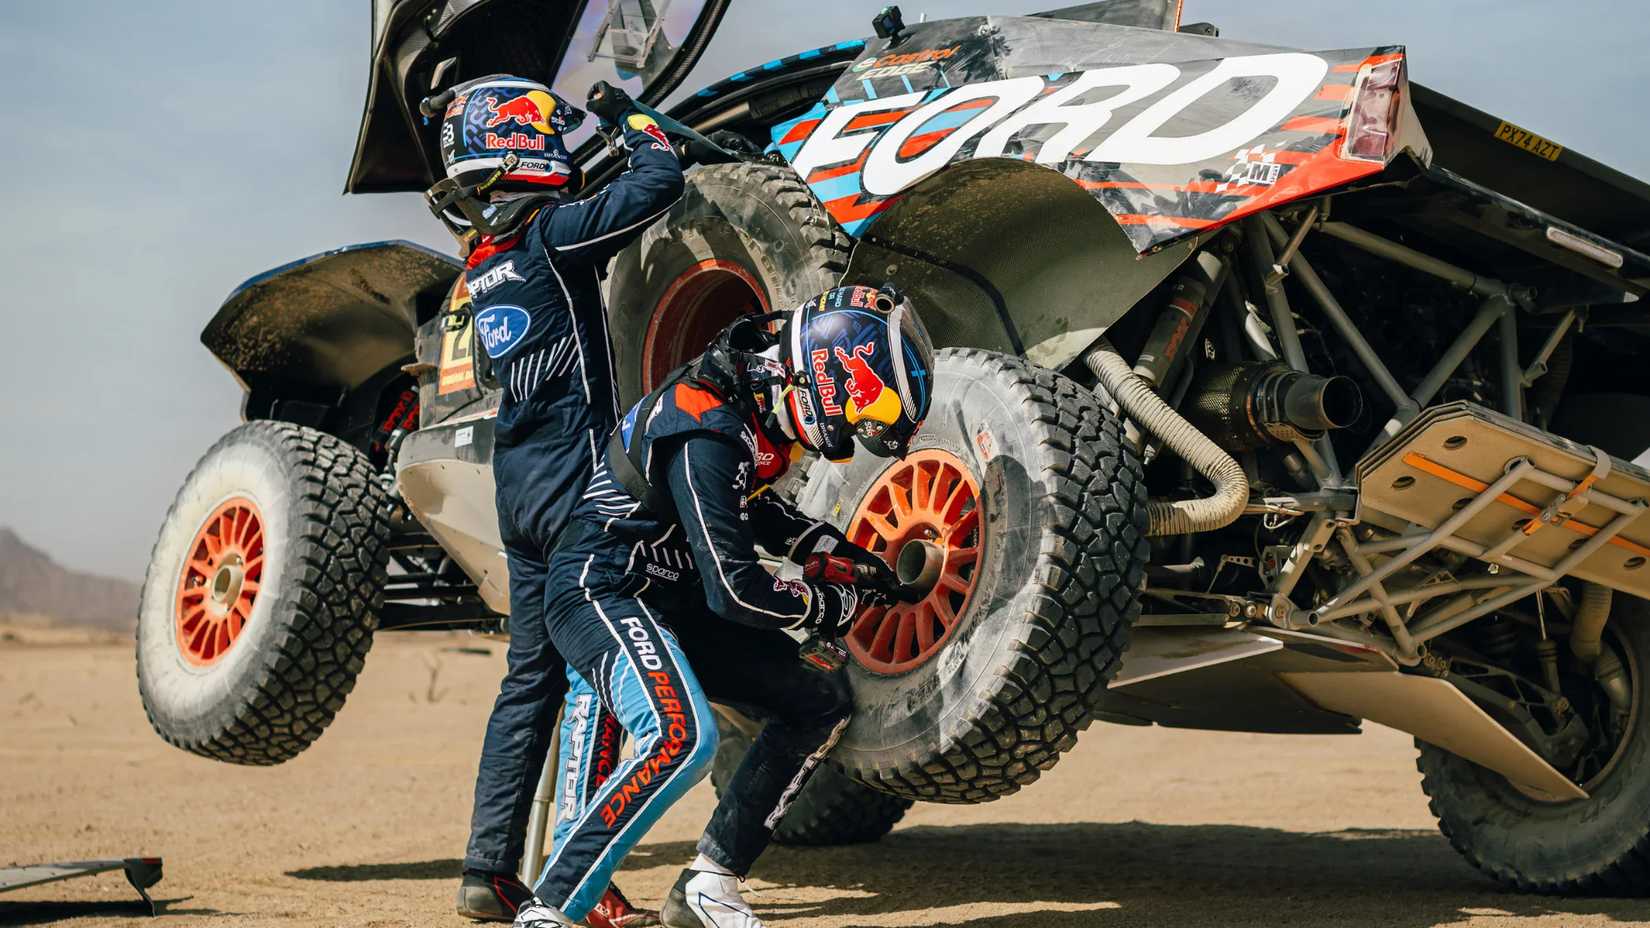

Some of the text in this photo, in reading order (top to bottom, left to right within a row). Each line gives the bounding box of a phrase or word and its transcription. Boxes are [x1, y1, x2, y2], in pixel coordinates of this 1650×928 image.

[486, 132, 545, 150] Red Bull
[791, 53, 1328, 195] FORD
[1500, 124, 1561, 159] PX74 AZT
[520, 161, 545, 169] FORD
[467, 259, 526, 299] PTOR
[478, 313, 512, 351] Ford
[811, 348, 835, 386] Red
[800, 391, 813, 417] FORD
[818, 383, 844, 416] Bull
[646, 562, 679, 581] sparco
[600, 616, 688, 828] FORD PERFORMANCE
[558, 693, 592, 820] RAPTOR
